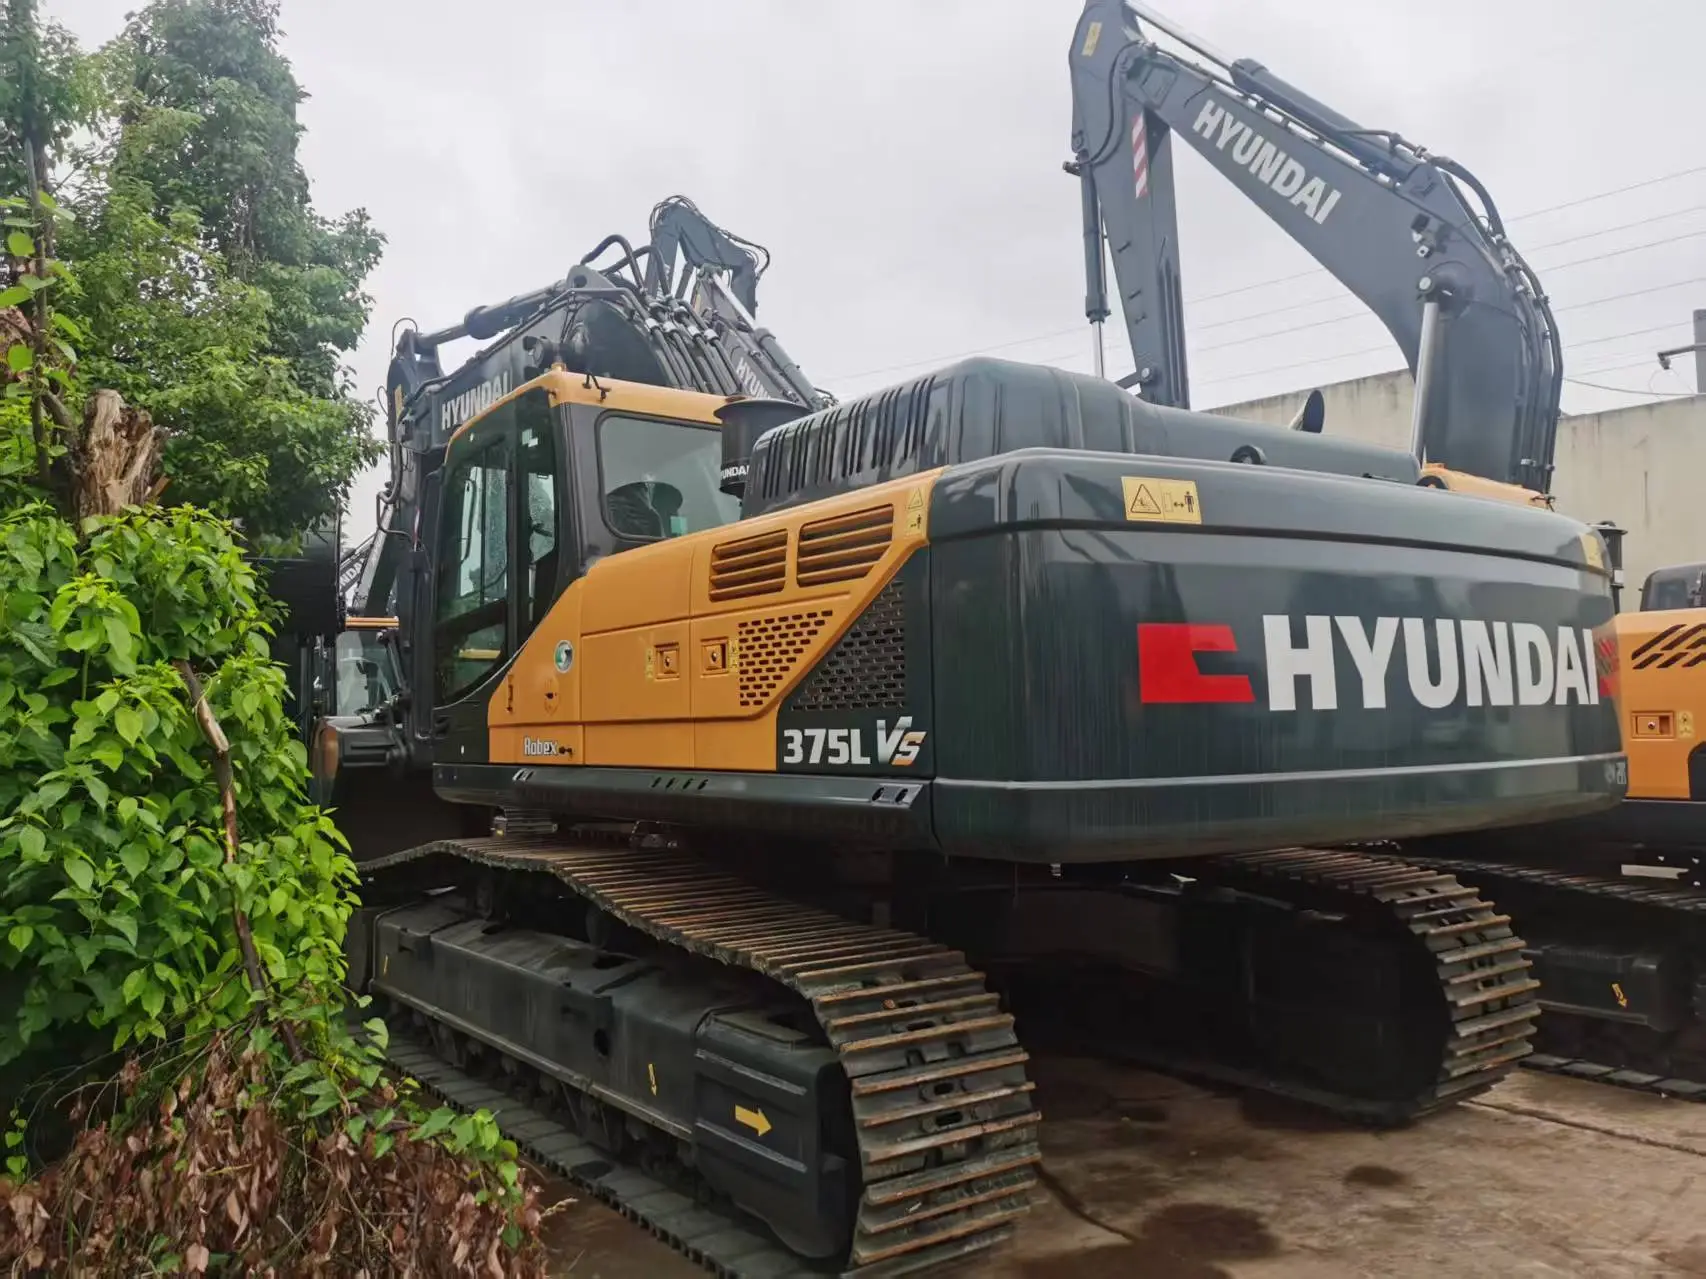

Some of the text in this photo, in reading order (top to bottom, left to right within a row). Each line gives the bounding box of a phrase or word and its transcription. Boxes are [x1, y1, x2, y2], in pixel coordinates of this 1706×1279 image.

[1192, 99, 1342, 225] HYUNDAI
[442, 371, 509, 431] HYUNDAI
[736, 357, 772, 400] HYUN
[1262, 614, 1599, 711] HYUNDAI
[524, 737, 557, 756] Robex
